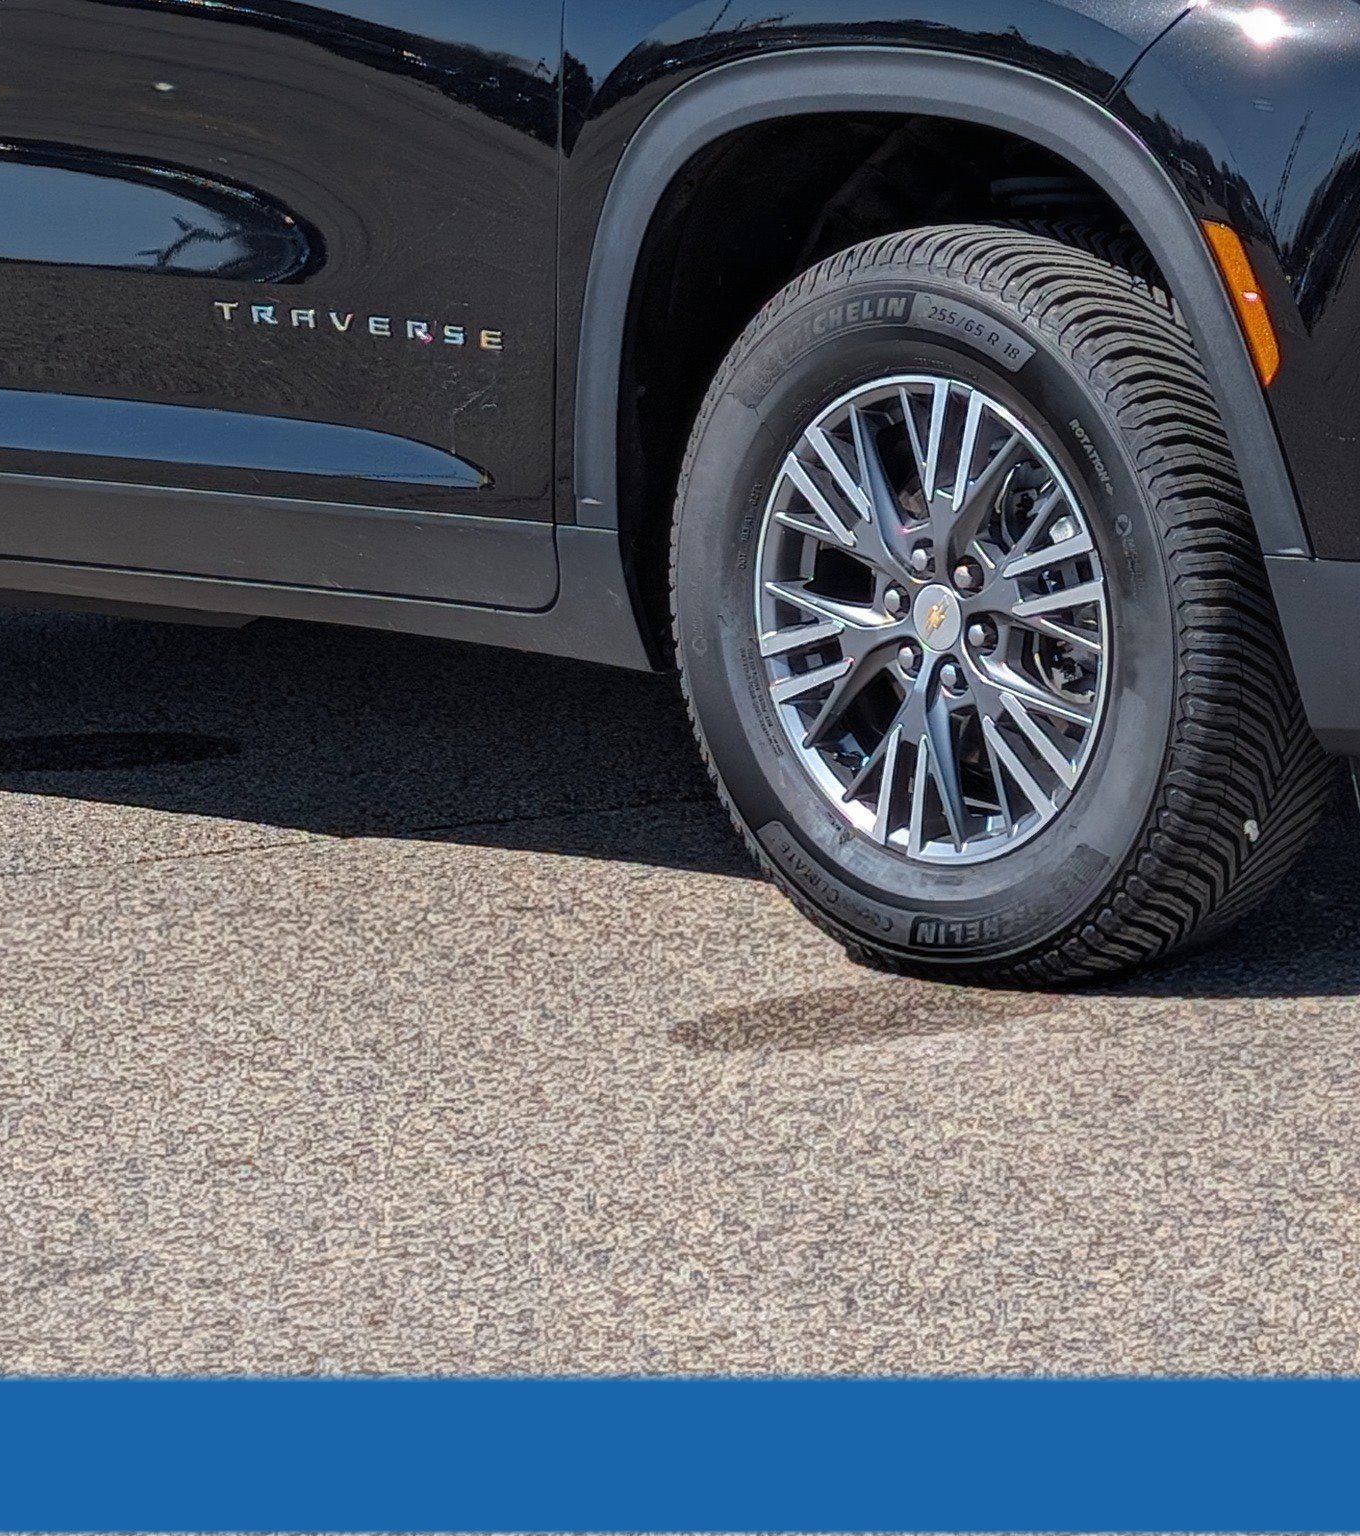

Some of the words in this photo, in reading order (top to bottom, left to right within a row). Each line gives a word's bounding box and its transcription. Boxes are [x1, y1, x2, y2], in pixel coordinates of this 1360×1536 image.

[214, 301, 504, 351] TRAVERSE
[927, 306, 984, 337] 255/65
[987, 332, 1000, 346] R
[1003, 342, 1022, 360] 18
[1068, 418, 1112, 483] ROTATION
